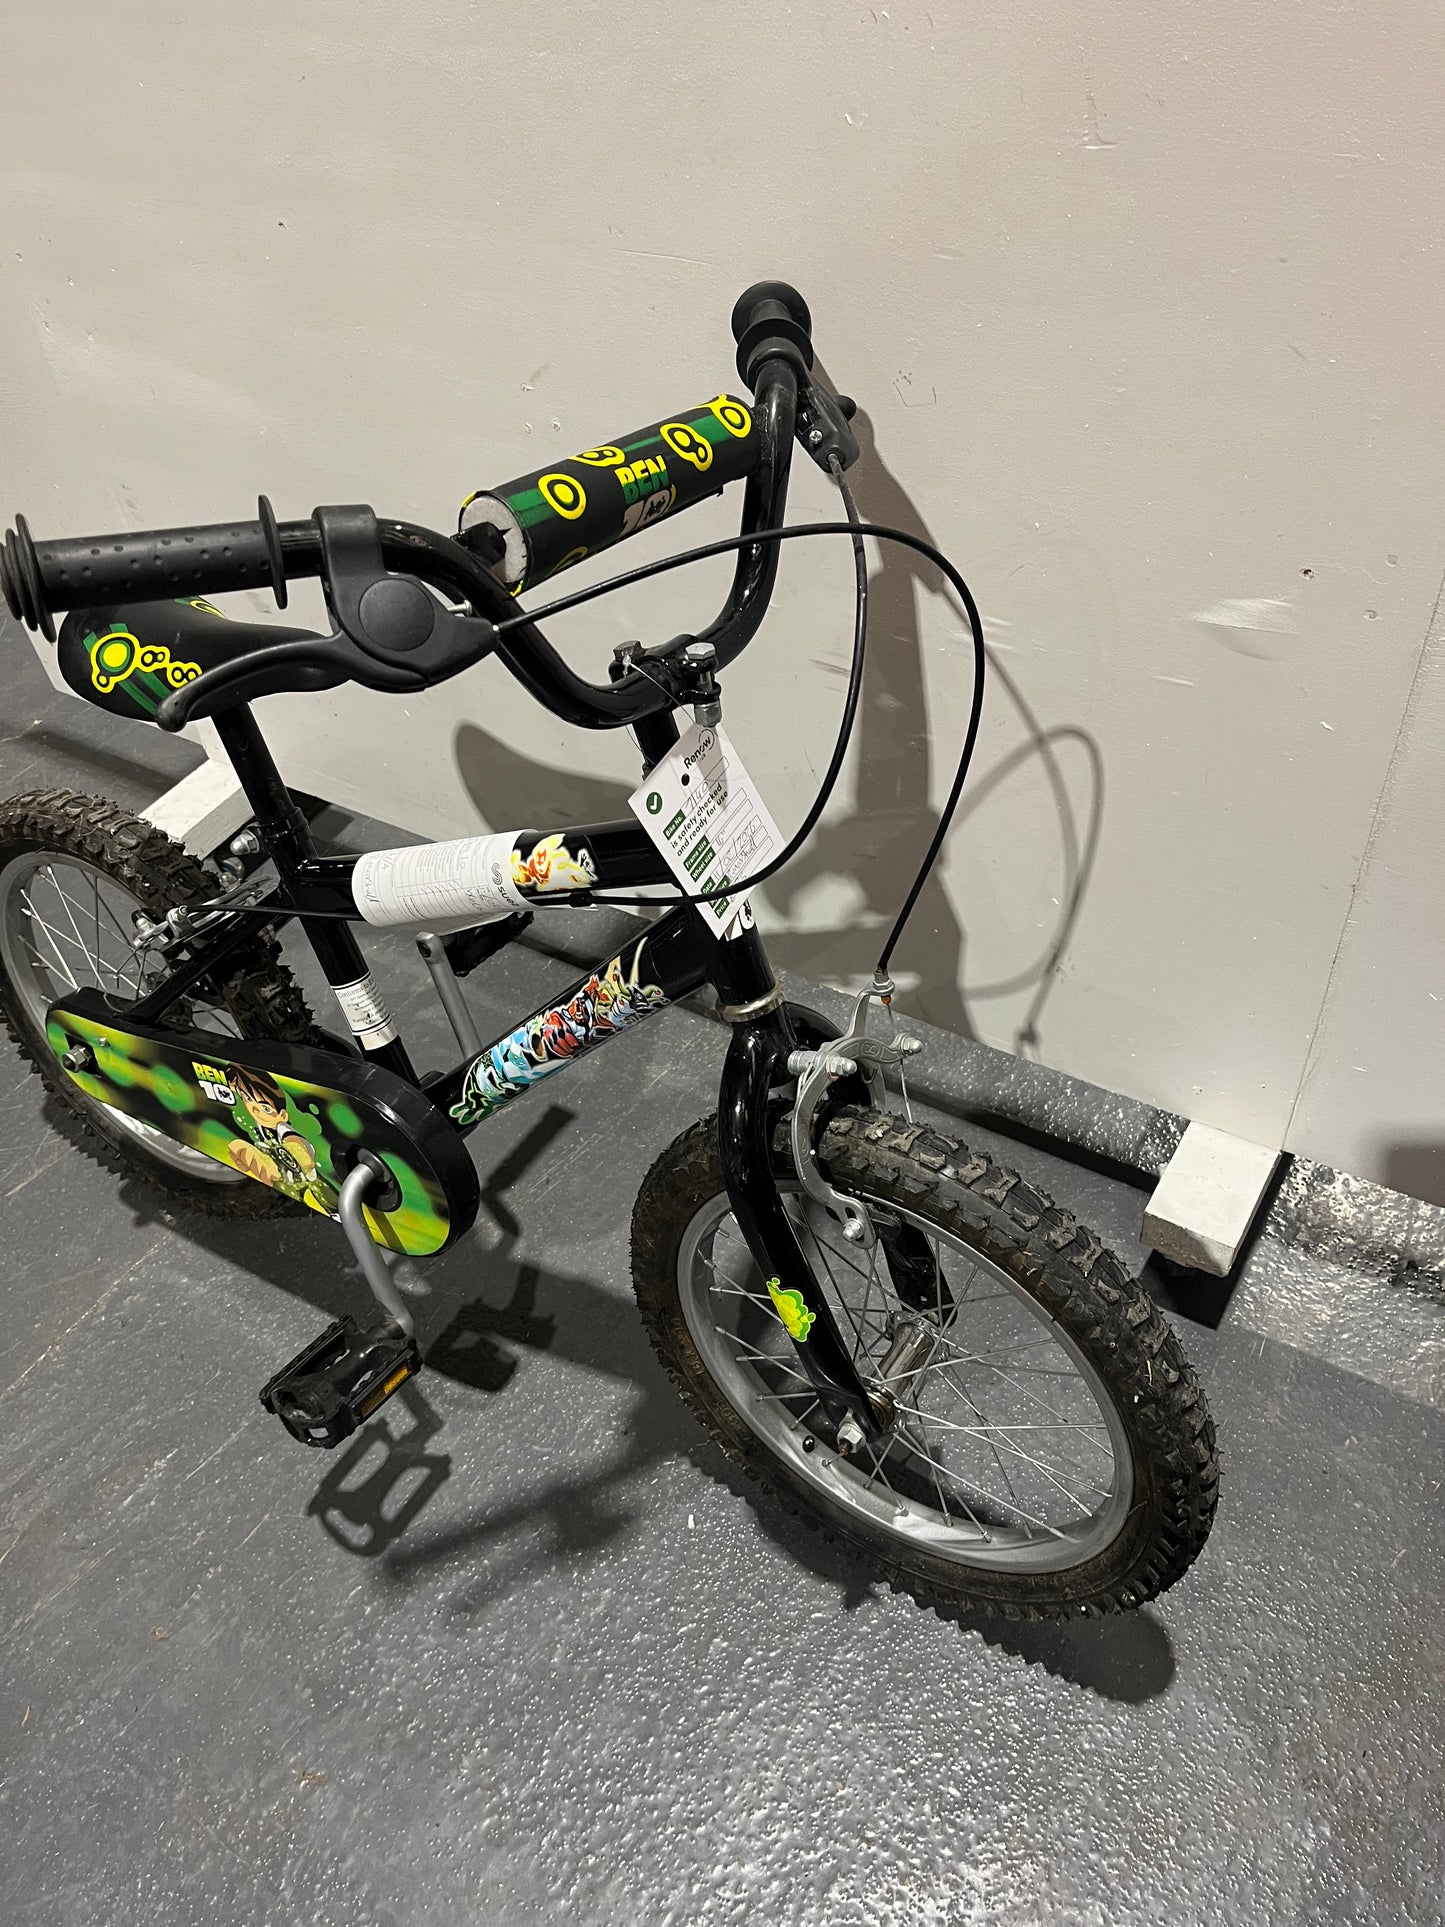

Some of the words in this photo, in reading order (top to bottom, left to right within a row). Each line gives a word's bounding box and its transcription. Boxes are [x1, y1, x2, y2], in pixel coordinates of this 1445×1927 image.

[614, 454, 669, 505] BEN
[618, 488, 671, 537] 10
[670, 841, 678, 849] is
[678, 816, 697, 840] safety
[696, 782, 723, 817] checked
[677, 838, 690, 856] and
[689, 817, 708, 841] ready
[706, 804, 717, 818] for
[716, 791, 728, 806] use
[665, 824, 676, 838] Bike
[686, 849, 699, 867] Frame
[698, 840, 707, 851] size
[692, 861, 706, 879] Wheel
[705, 851, 713, 863] size
[702, 881, 713, 894] Date
[716, 901, 727, 917] Price
[191, 1061, 228, 1086] BEN
[198, 1080, 236, 1105] 10
